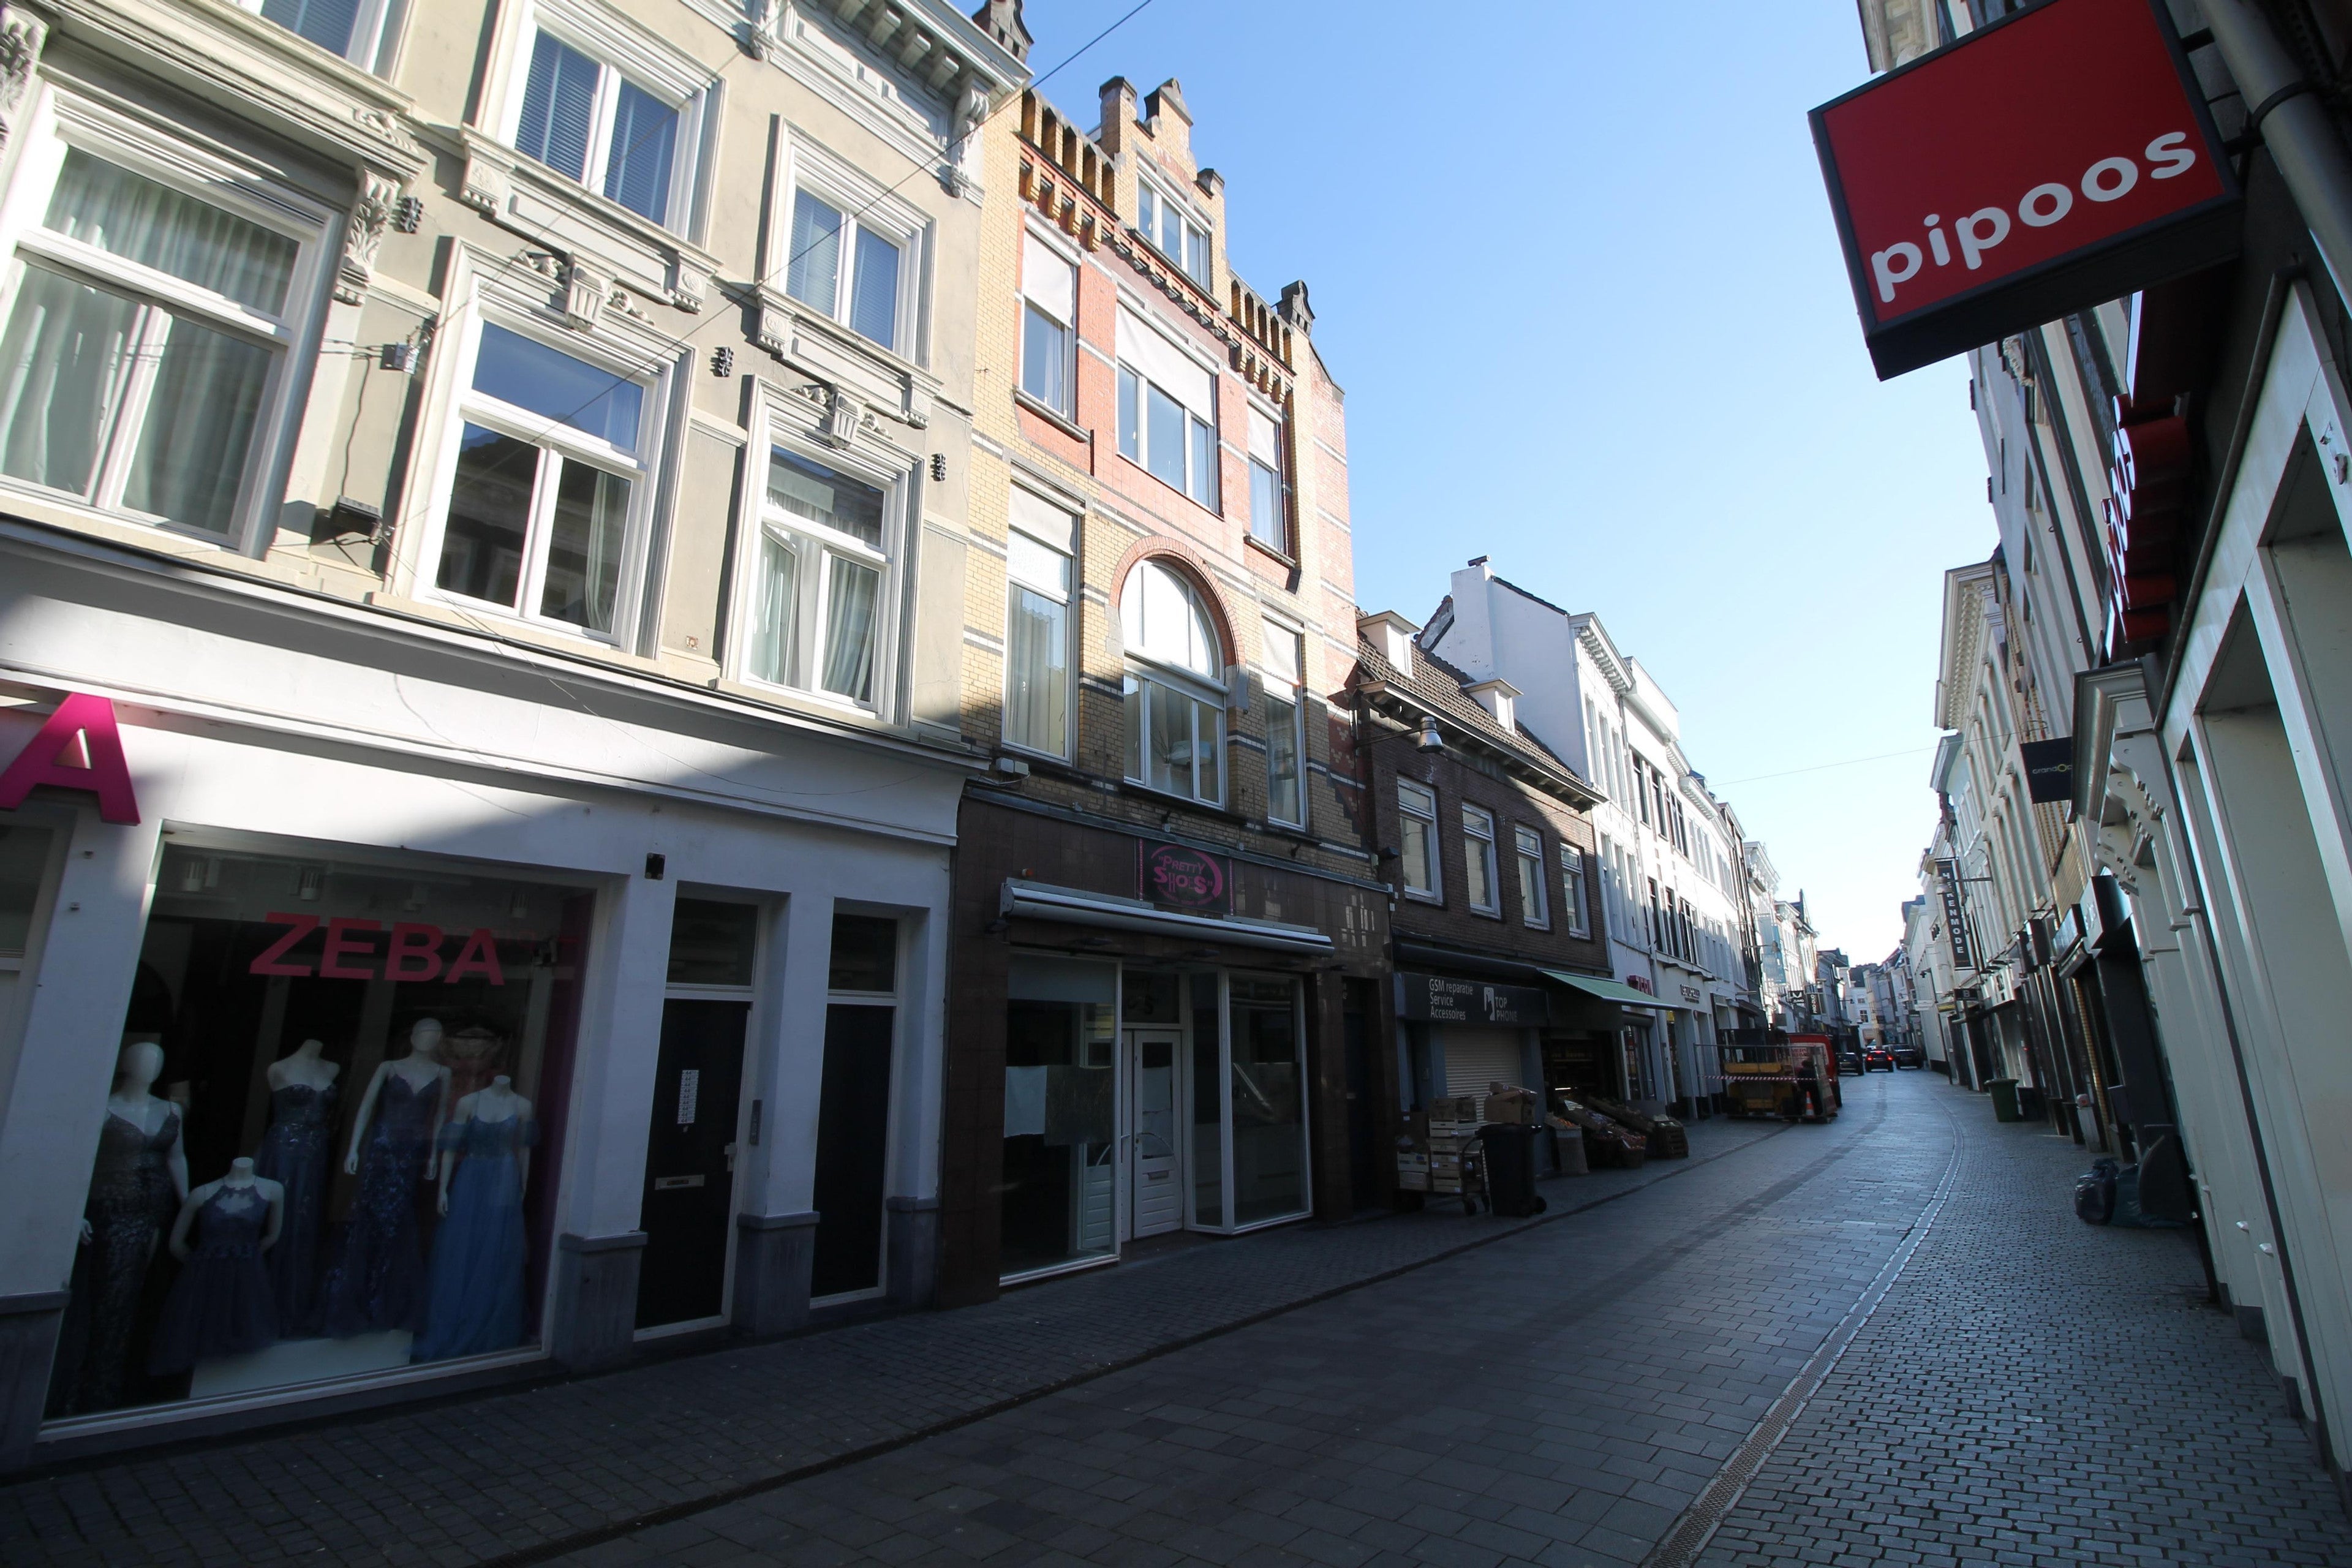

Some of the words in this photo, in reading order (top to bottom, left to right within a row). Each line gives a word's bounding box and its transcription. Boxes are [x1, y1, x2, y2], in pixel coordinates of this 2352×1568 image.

[1871, 131, 2196, 303] pipoos
[249, 912, 505, 986] ZEBA
[1429, 979, 1444, 992] GSM
[1446, 983, 1473, 995] reparatie
[1430, 992, 1453, 1006] Service
[1495, 996, 1507, 1008] TOP
[1430, 1006, 1466, 1020] Accessoires
[1496, 1010, 1518, 1022] PHONE
